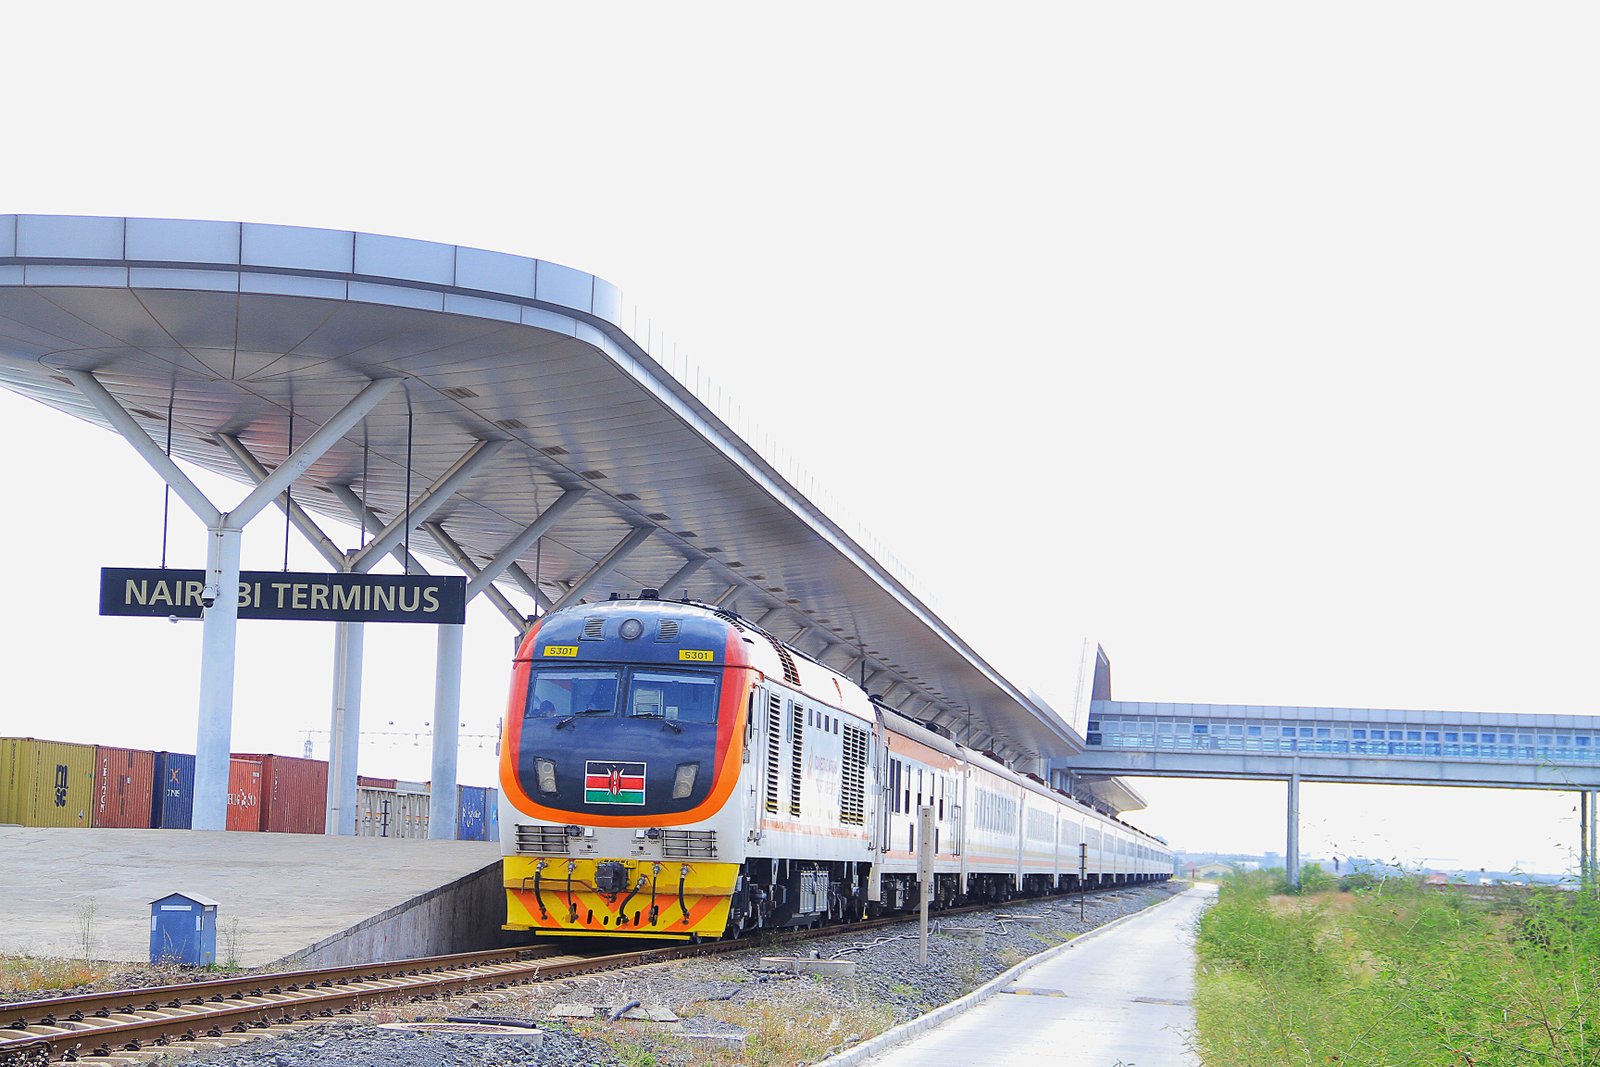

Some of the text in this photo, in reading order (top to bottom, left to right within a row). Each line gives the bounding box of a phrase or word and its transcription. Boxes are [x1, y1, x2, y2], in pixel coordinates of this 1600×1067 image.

[125, 579, 440, 612] NAIRBI TERMINUS
[550, 647, 573, 655] 5301
[684, 652, 708, 660] 5301
